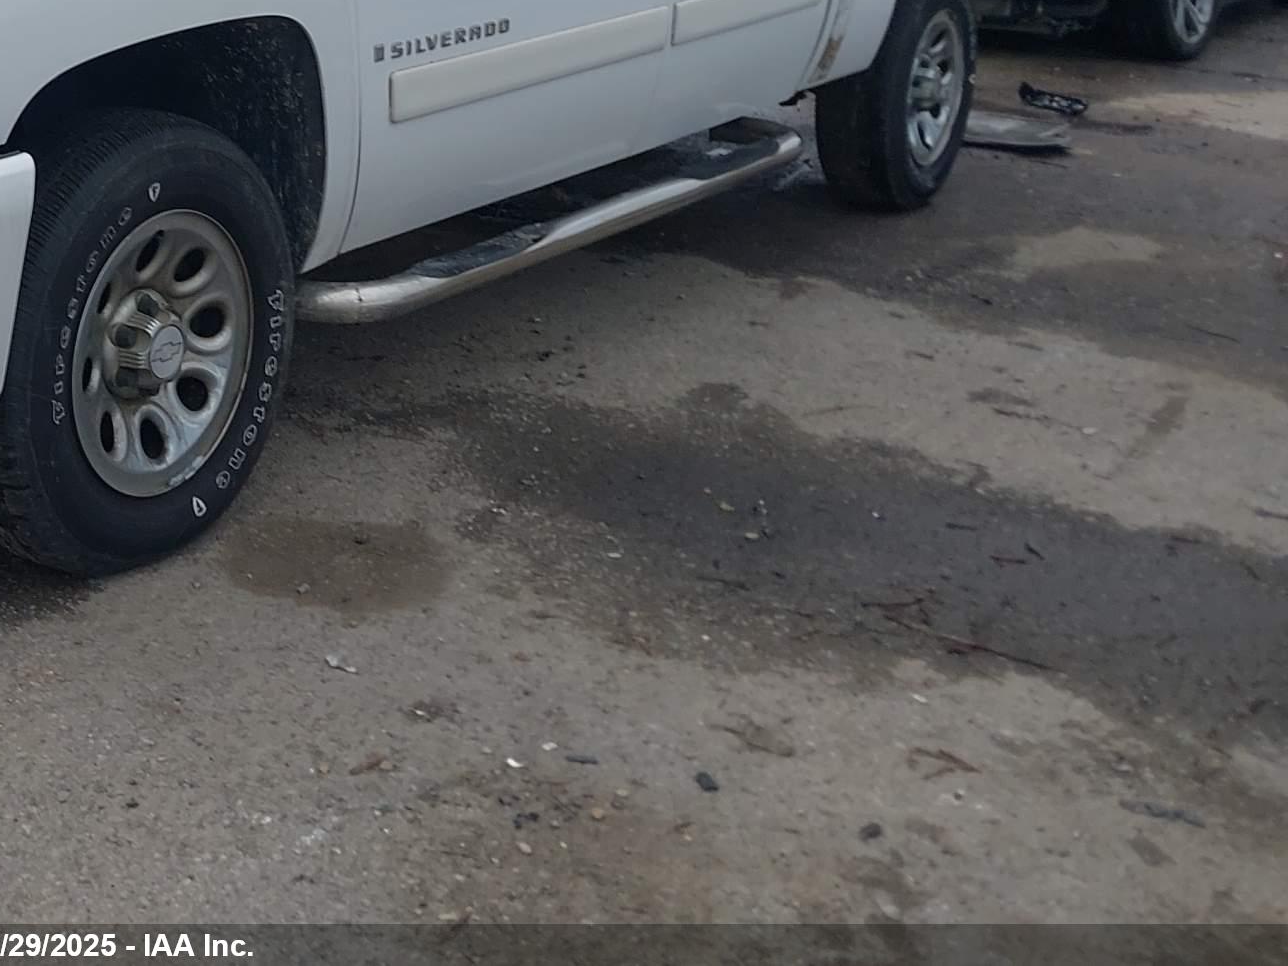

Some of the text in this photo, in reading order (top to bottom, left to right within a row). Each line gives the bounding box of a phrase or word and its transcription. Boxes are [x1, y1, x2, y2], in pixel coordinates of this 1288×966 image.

[389, 17, 511, 60] SILVERADO
[52, 206, 133, 426] Firestone
[215, 288, 285, 490] Firestone
